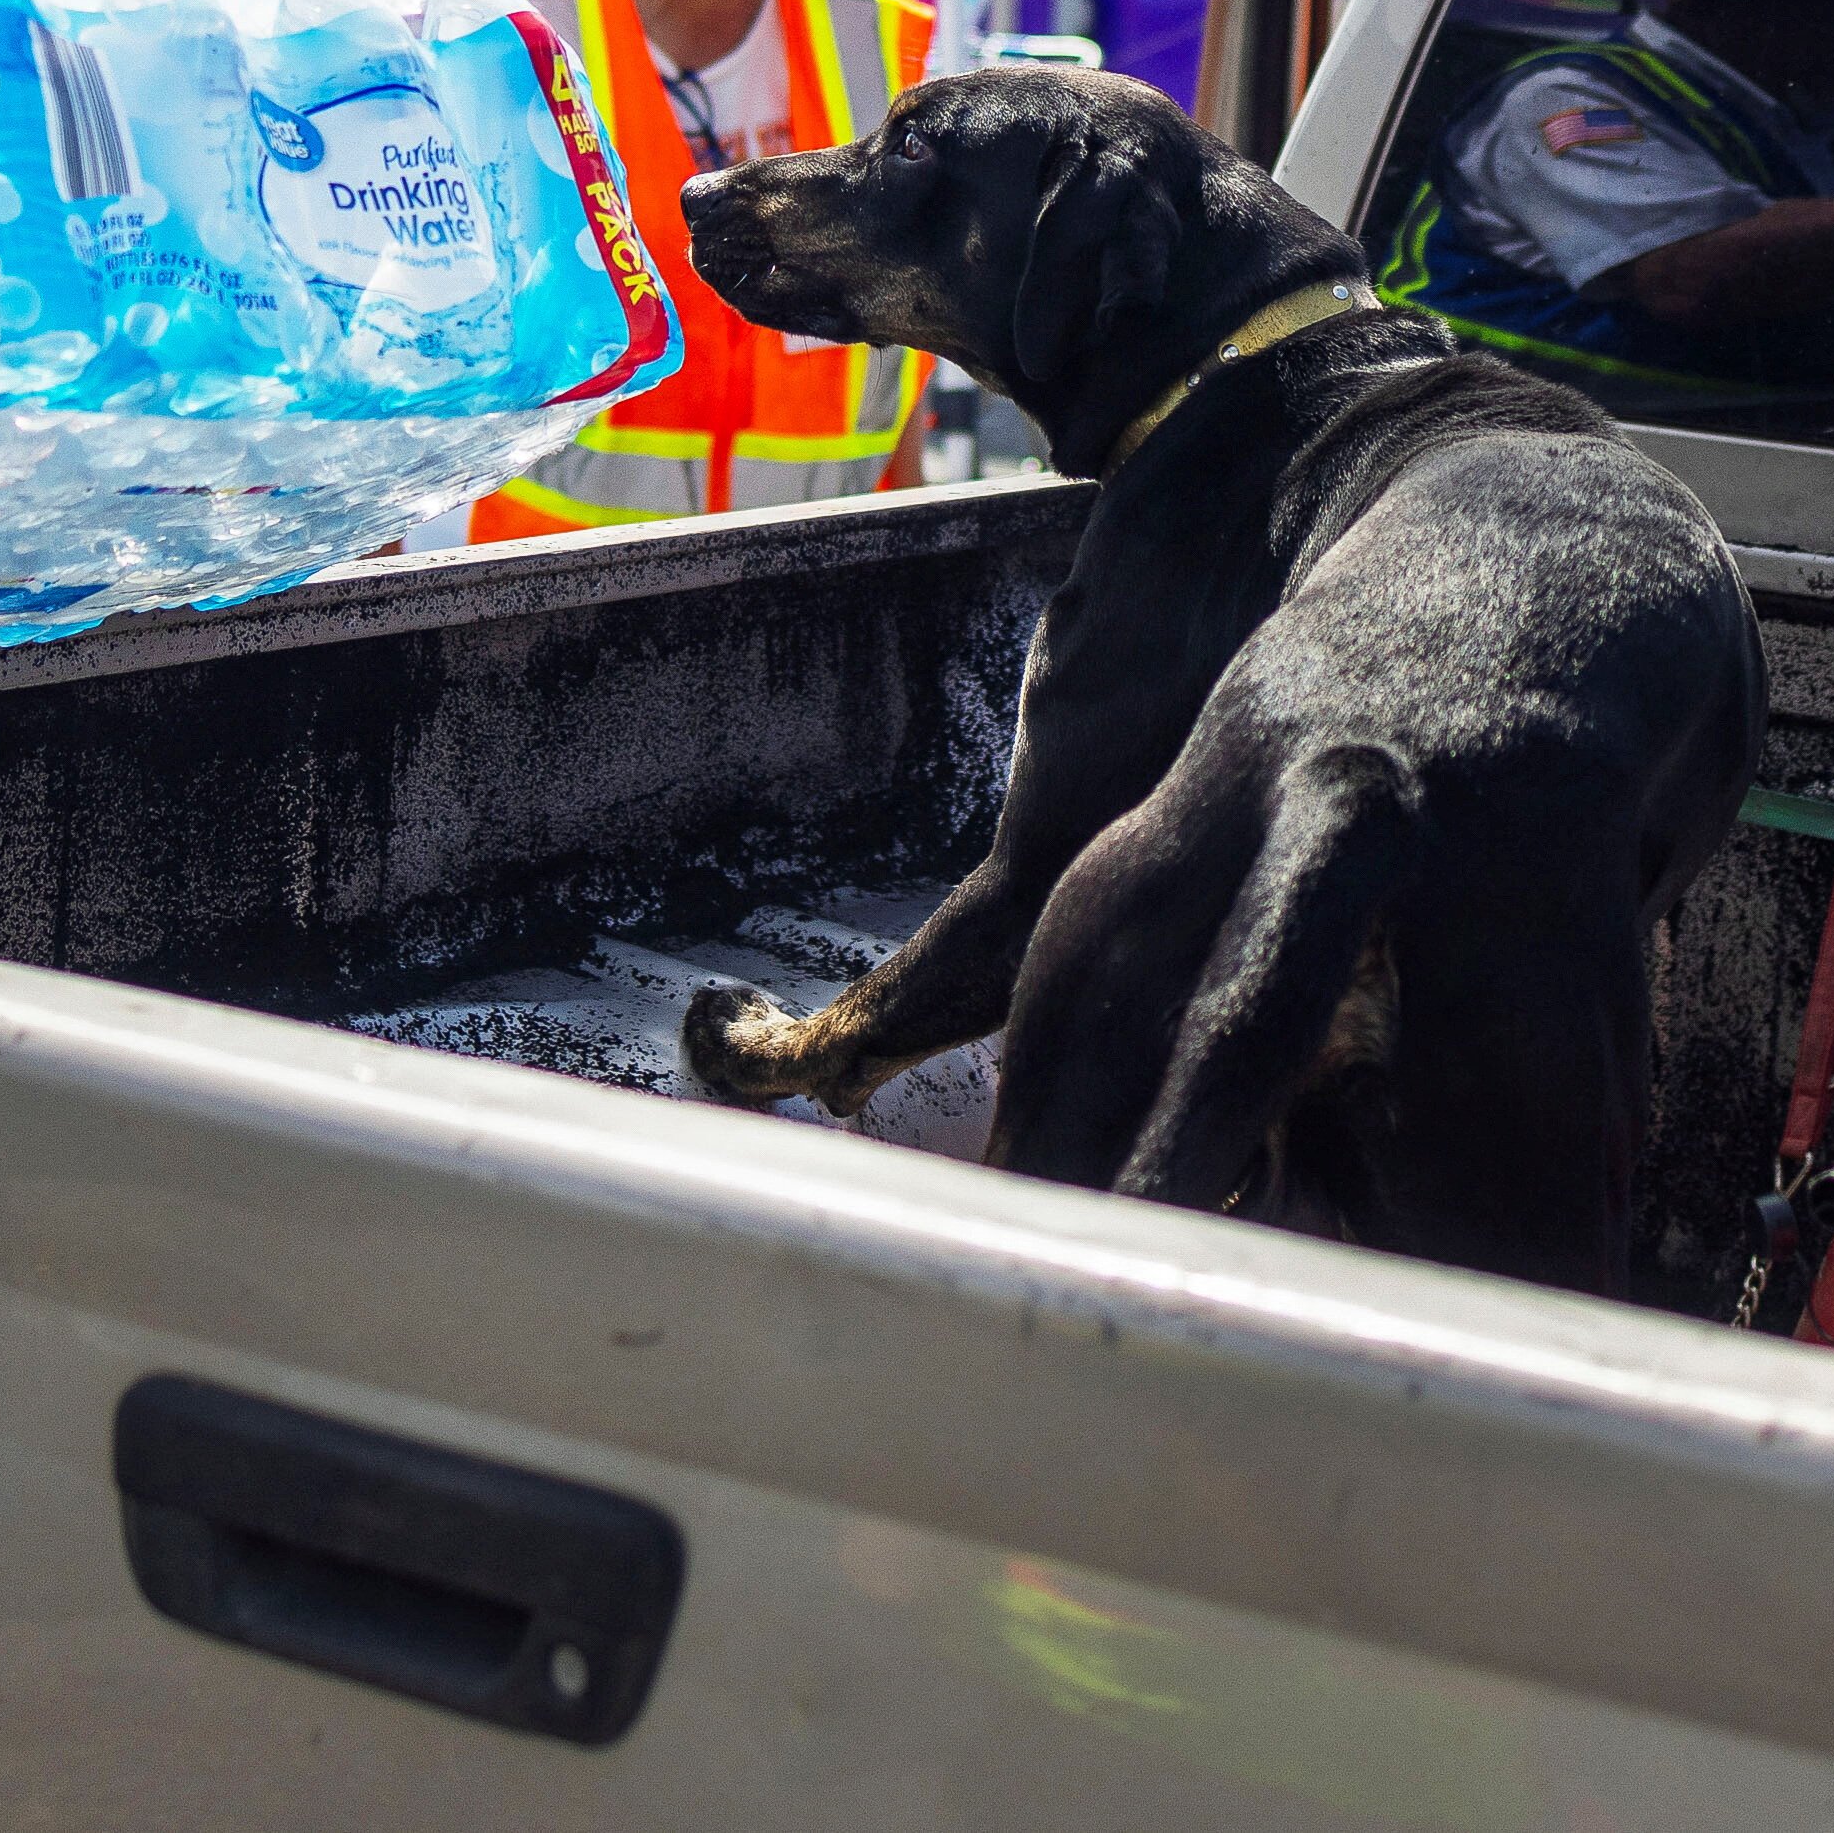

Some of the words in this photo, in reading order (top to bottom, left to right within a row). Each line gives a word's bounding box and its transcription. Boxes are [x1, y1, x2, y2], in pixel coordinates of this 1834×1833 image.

[328, 170, 470, 216] Drinking
[585, 180, 660, 306] PACK
[232, 291, 279, 312] TOTAL
